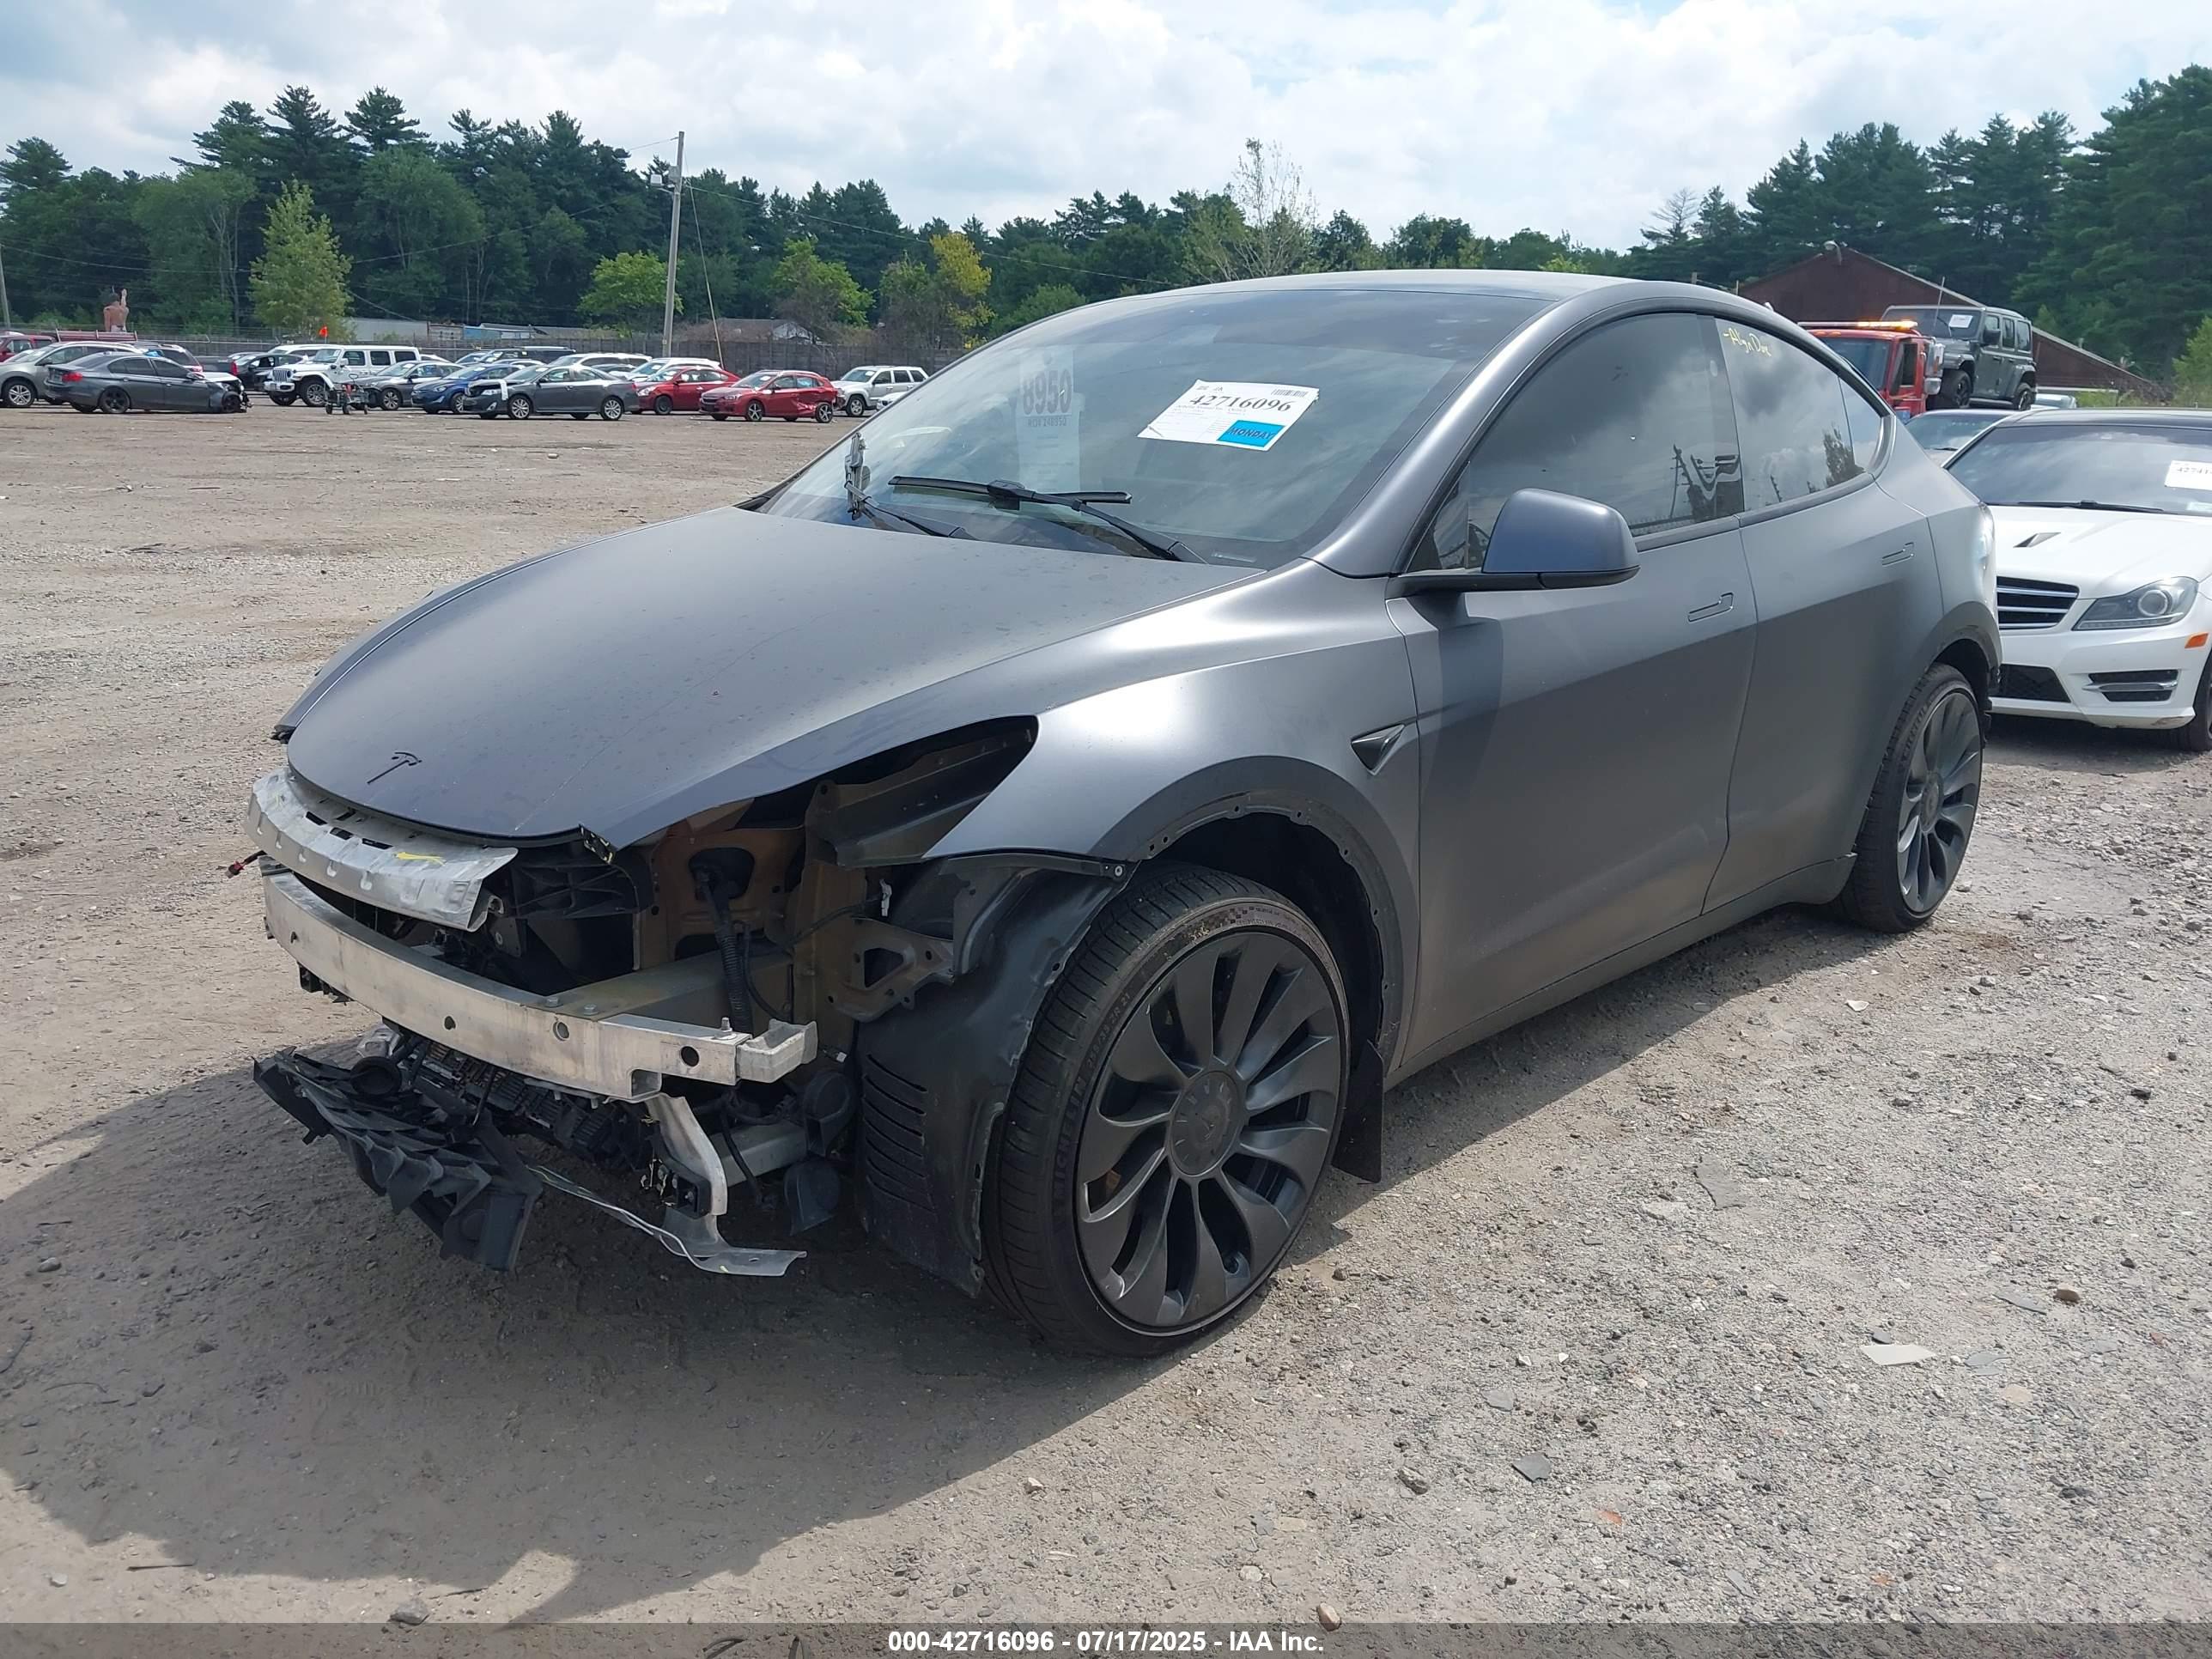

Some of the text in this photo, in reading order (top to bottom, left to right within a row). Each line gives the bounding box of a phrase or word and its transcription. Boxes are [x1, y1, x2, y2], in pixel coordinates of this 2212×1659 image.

[1022, 368, 1073, 416] 8950
[1190, 394, 1297, 412] 42716096
[1227, 428, 1277, 441] MONDAY
